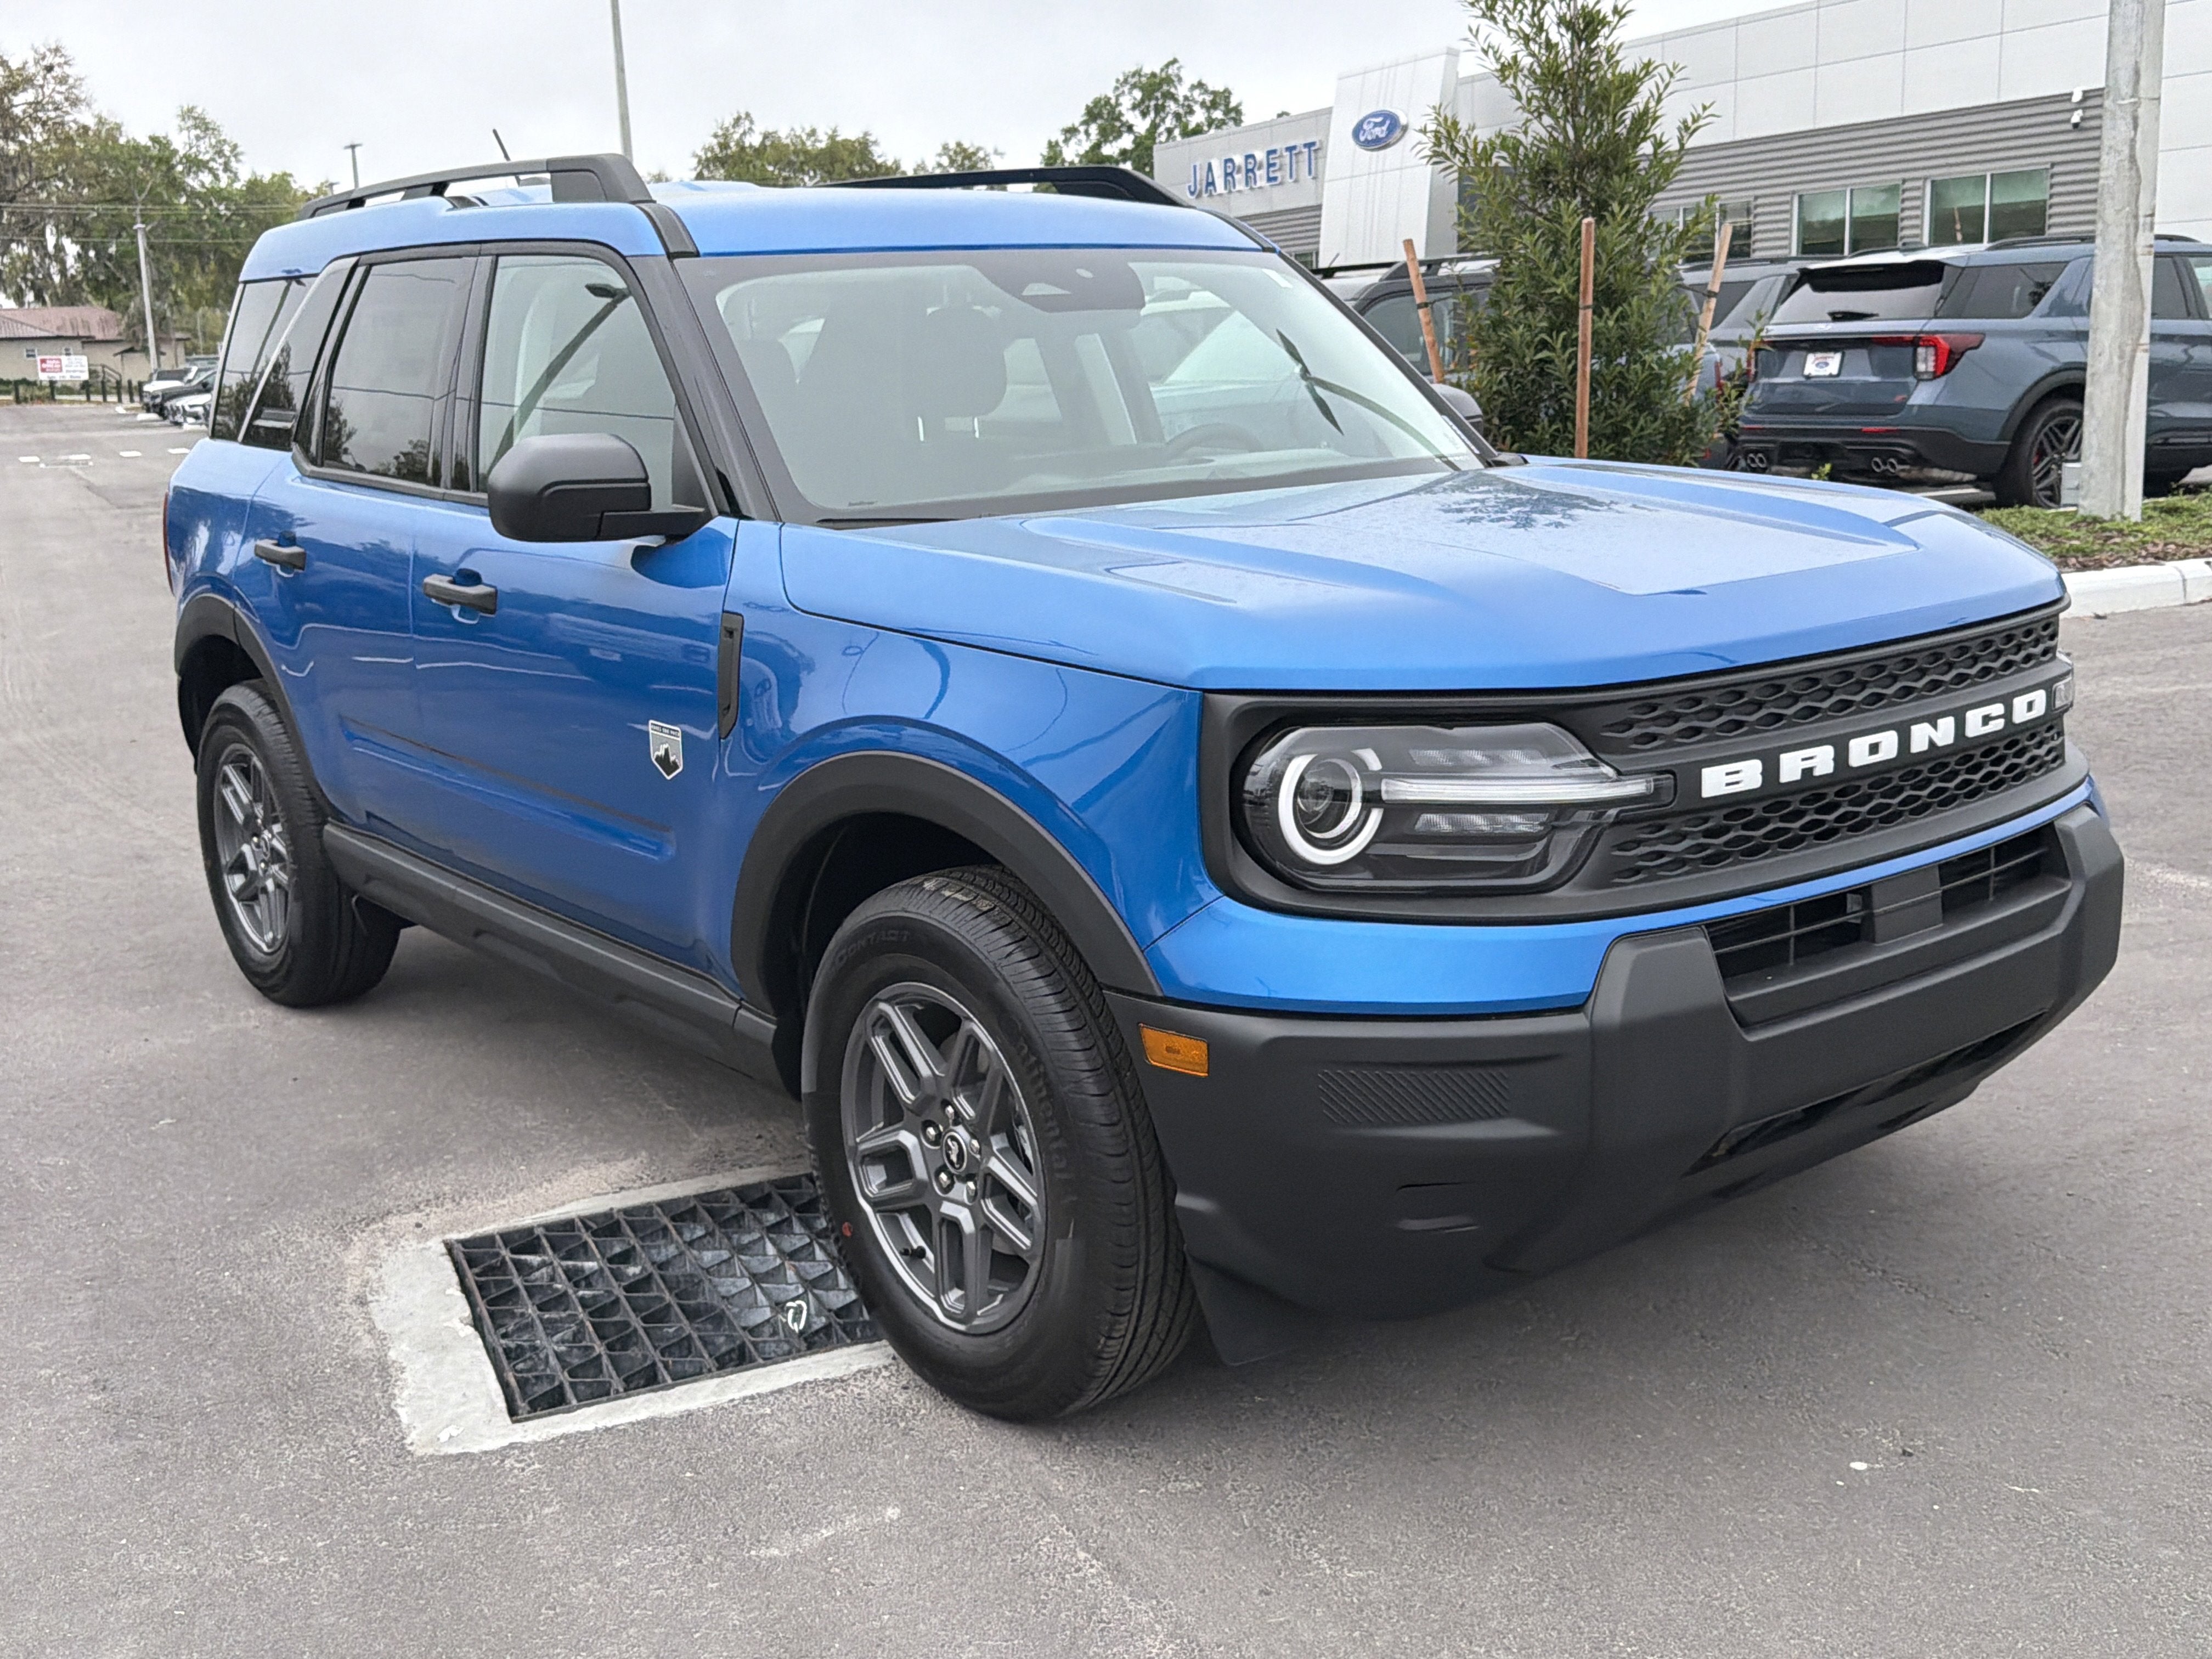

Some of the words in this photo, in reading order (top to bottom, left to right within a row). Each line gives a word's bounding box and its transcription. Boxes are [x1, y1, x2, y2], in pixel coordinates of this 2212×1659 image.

[1359, 117, 1390, 141] Ford
[1188, 141, 1317, 197] JARRETT
[1701, 689, 2046, 798] BRONCO
